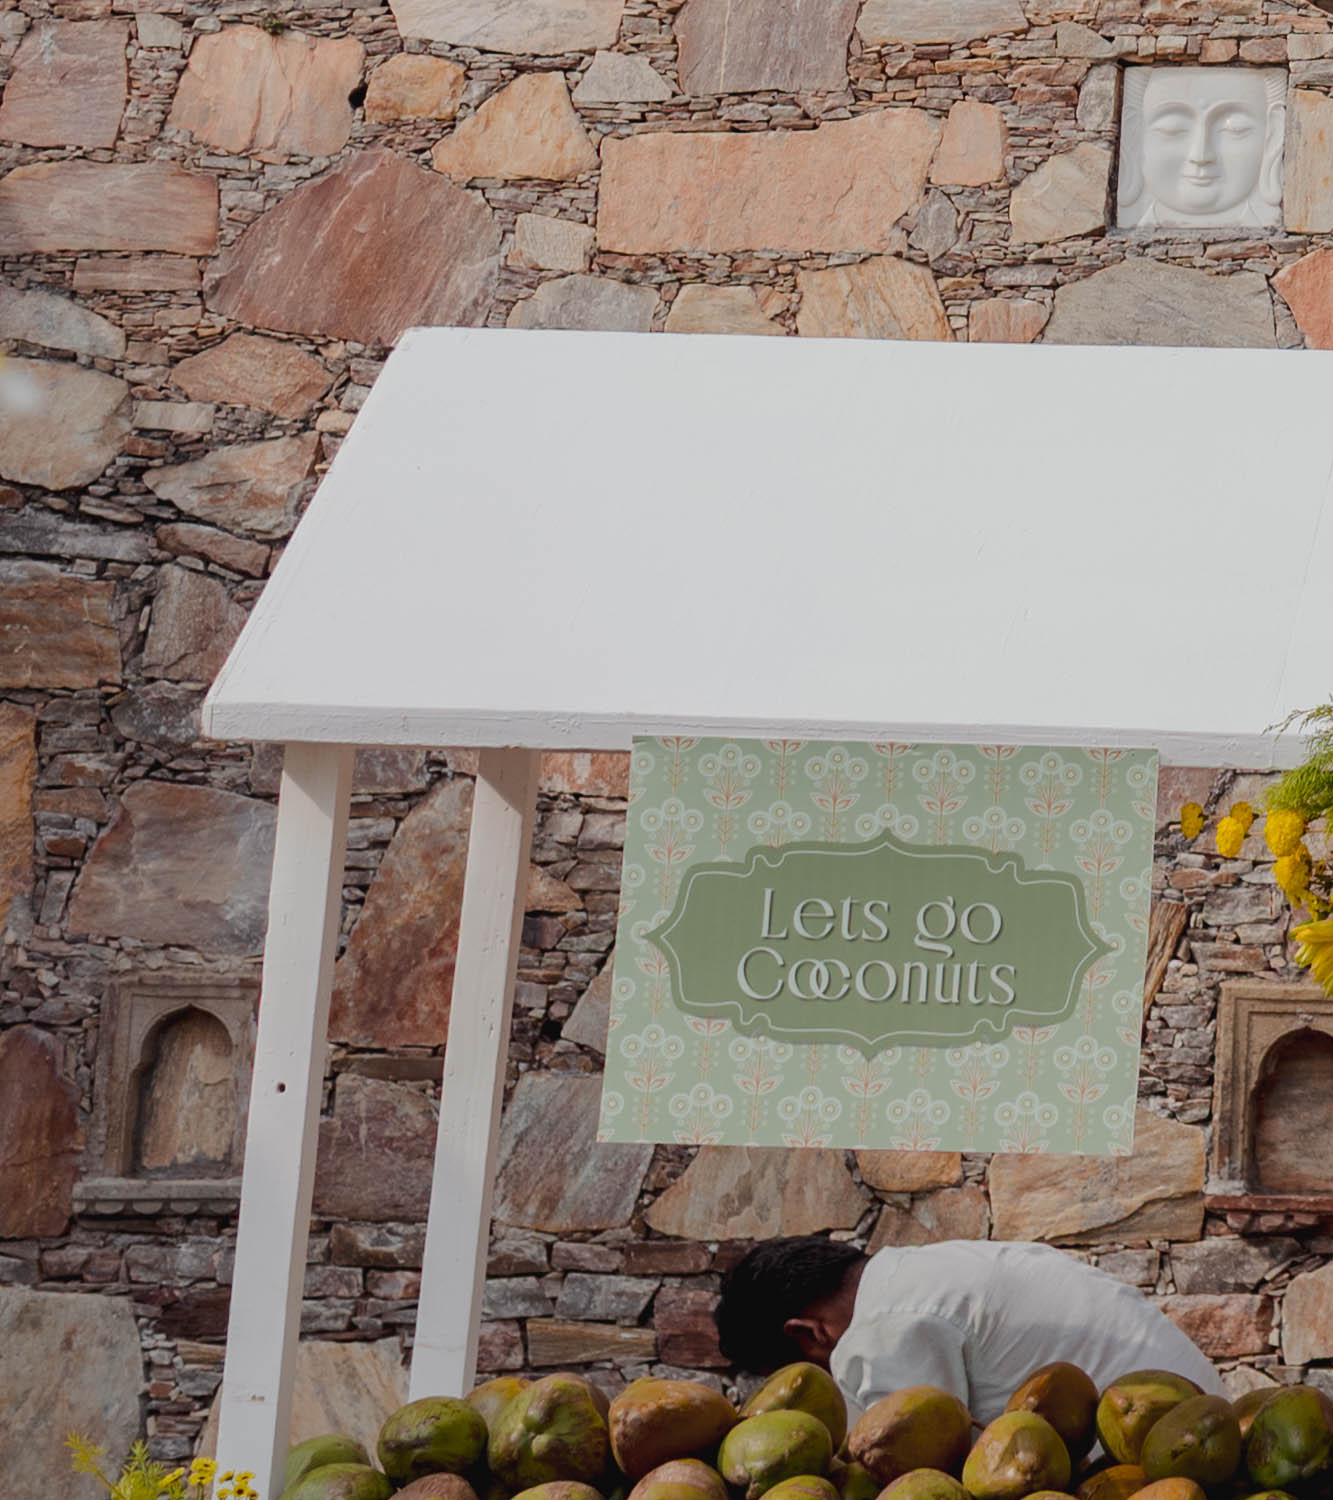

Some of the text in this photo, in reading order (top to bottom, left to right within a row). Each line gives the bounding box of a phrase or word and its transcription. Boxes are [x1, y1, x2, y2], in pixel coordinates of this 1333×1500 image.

[759, 887, 1004, 958] Lets go
[736, 946, 1018, 1005] Coconuts
